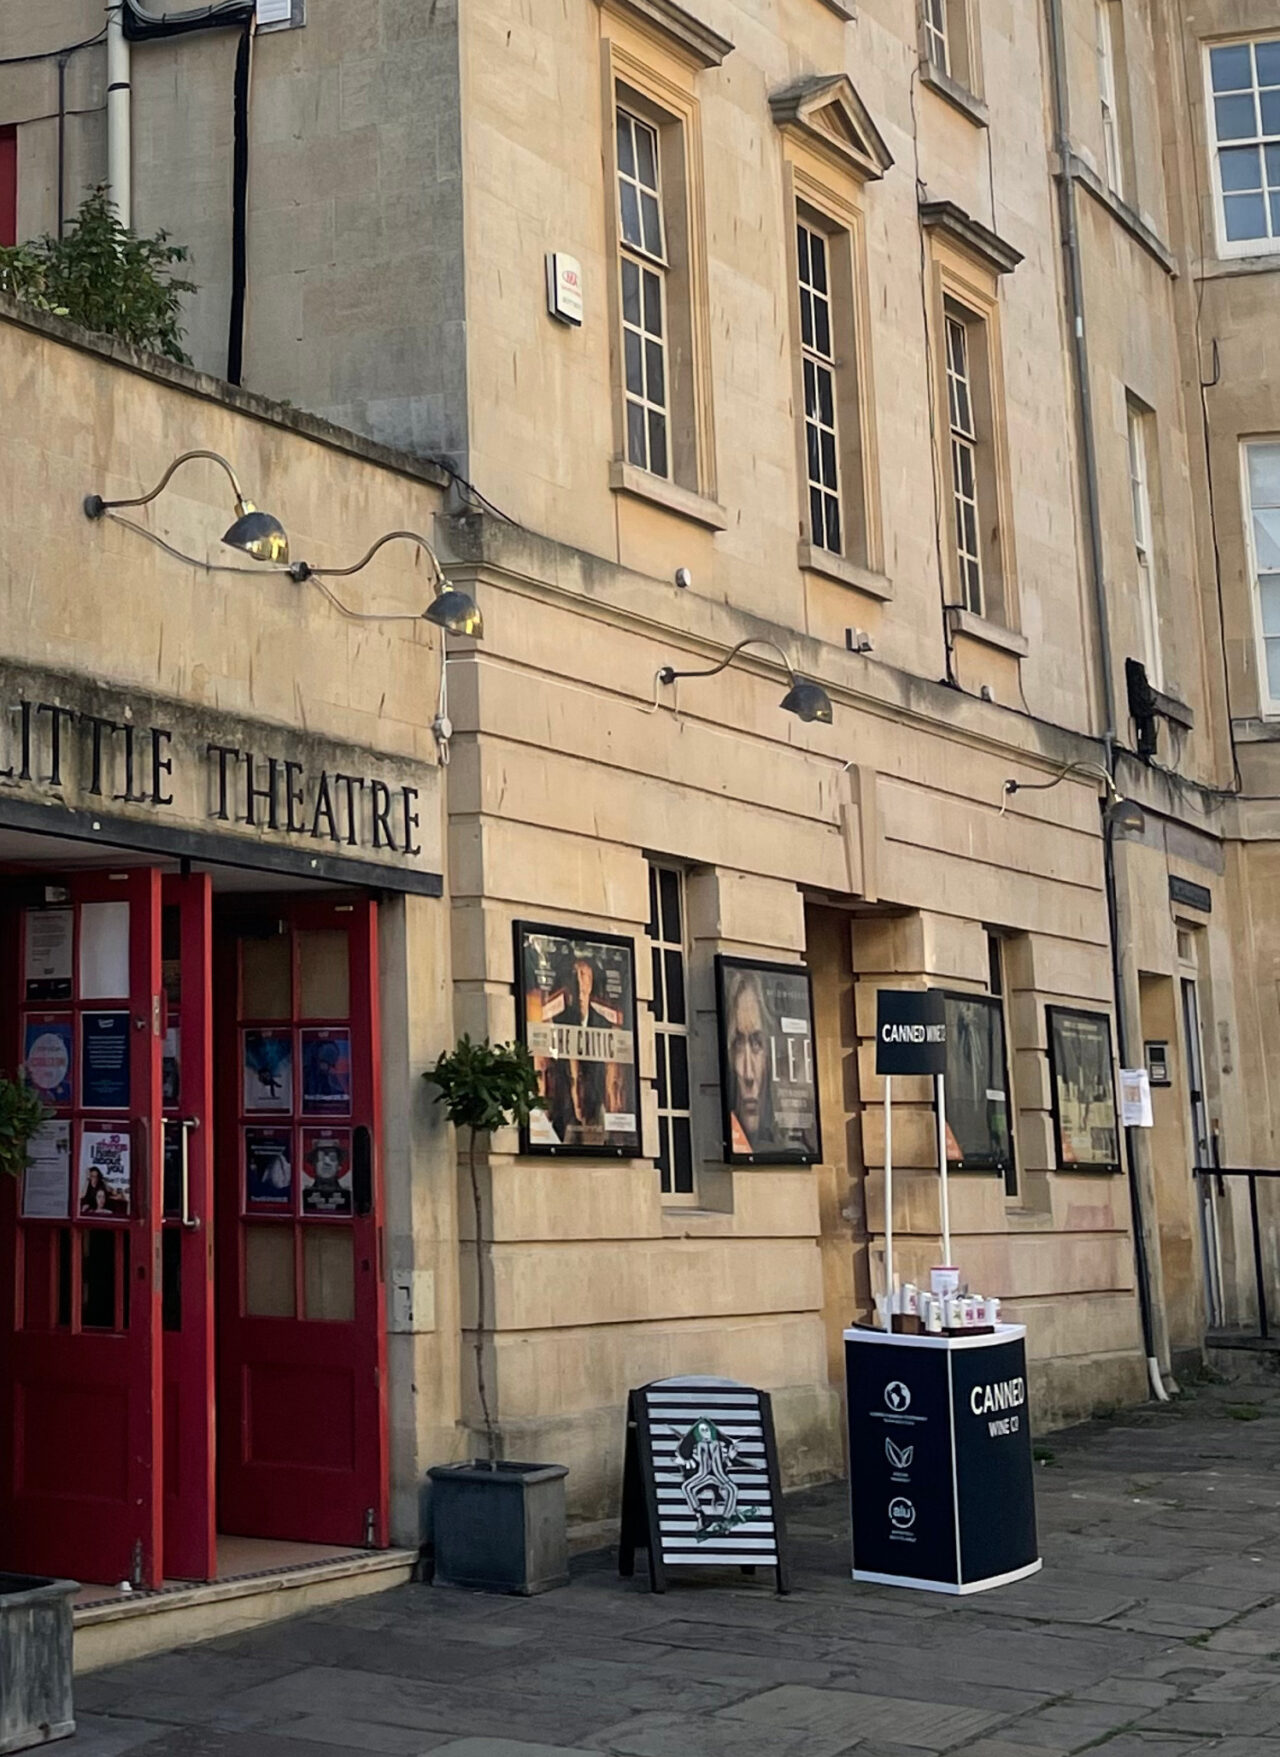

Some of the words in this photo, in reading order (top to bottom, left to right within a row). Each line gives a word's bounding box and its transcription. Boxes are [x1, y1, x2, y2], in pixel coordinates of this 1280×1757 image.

[206, 743, 421, 855] THEATRE
[577, 1030, 614, 1058] CRITIC
[882, 1024, 925, 1042] CANNED
[771, 1036, 813, 1084] LEE
[971, 1377, 1024, 1415] CANNED
[988, 1418, 1010, 1437] WINE
